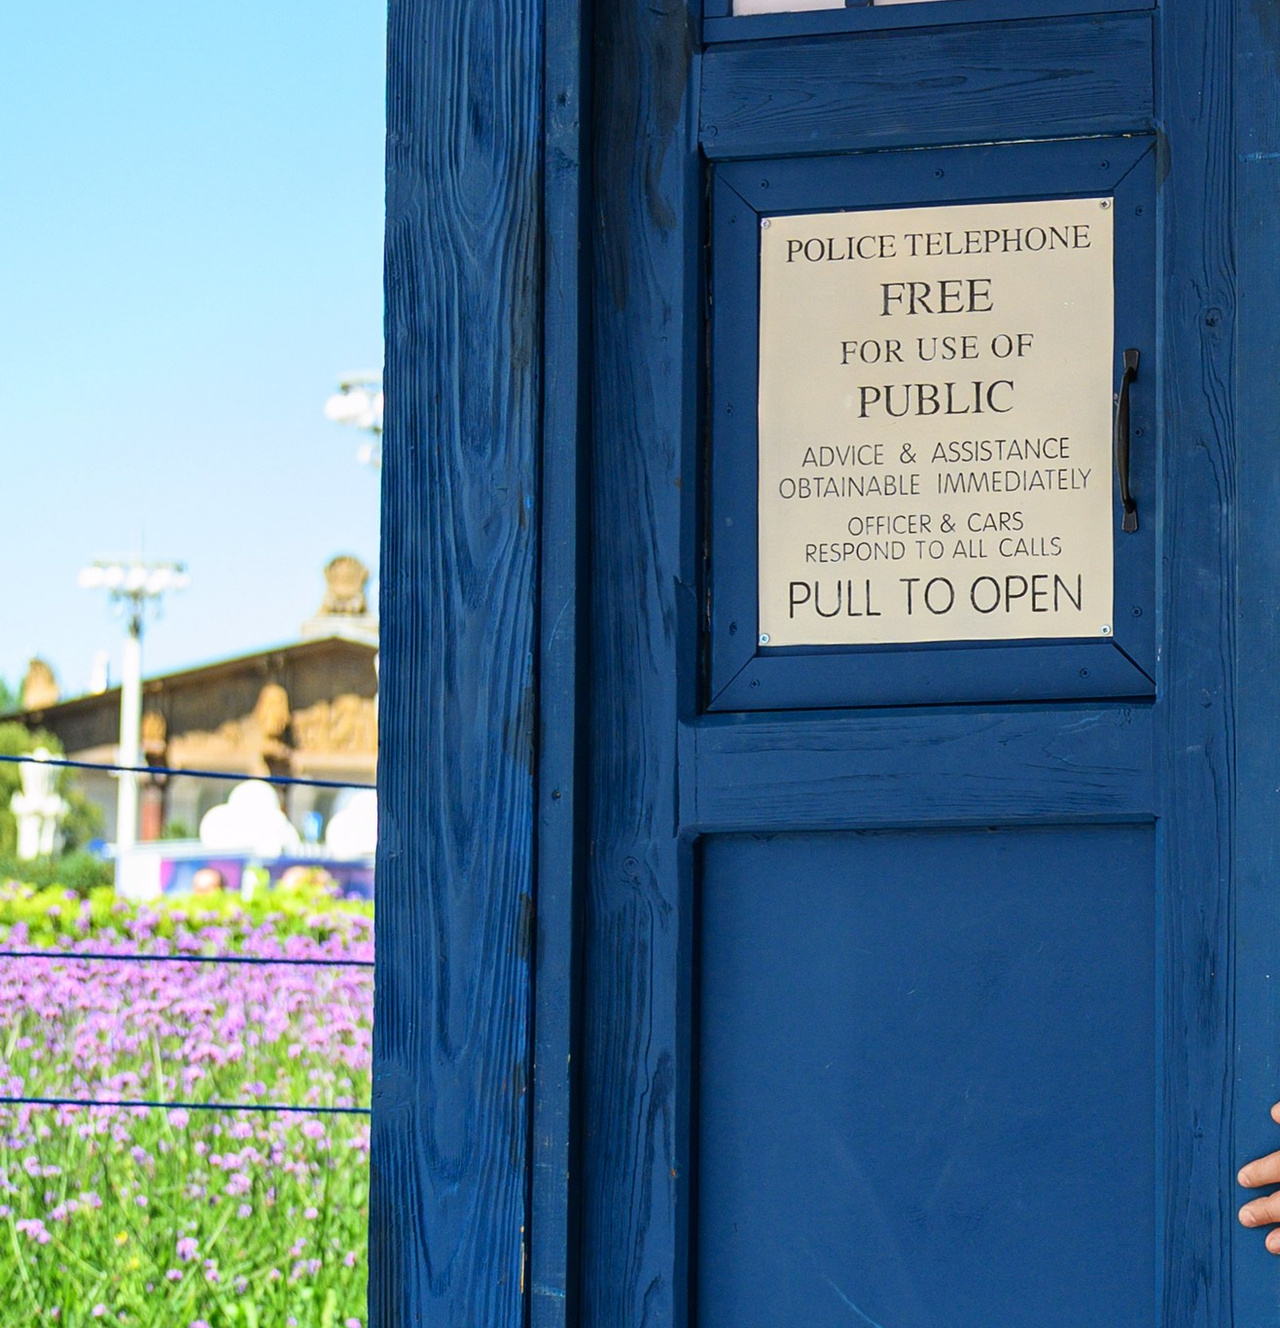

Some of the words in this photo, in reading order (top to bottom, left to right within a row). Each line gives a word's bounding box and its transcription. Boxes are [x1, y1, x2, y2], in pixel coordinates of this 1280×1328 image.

[786, 235, 896, 262] POLICE
[904, 225, 1091, 256] TELEPHONE
[880, 279, 993, 316] FREE
[841, 340, 904, 365] FOR
[917, 336, 979, 361] USE
[991, 334, 1033, 358] OF
[858, 380, 1014, 418] PUBLIC
[802, 444, 883, 467] ADVICE
[900, 443, 916, 464] &
[931, 437, 1069, 463] ASSISTANCE
[779, 474, 920, 499] OBTAINABLE
[938, 468, 1091, 494] IMMEDIATELY
[848, 515, 931, 536] OFFICER
[940, 514, 955, 533] &
[968, 511, 1023, 532] CARS
[806, 541, 905, 562] RESPOND
[916, 540, 944, 559] TO
[953, 539, 987, 558] ALL
[999, 537, 1061, 557] CALLS
[790, 579, 881, 619] PULL
[899, 577, 954, 615] TO
[970, 574, 1081, 613] OPEN
